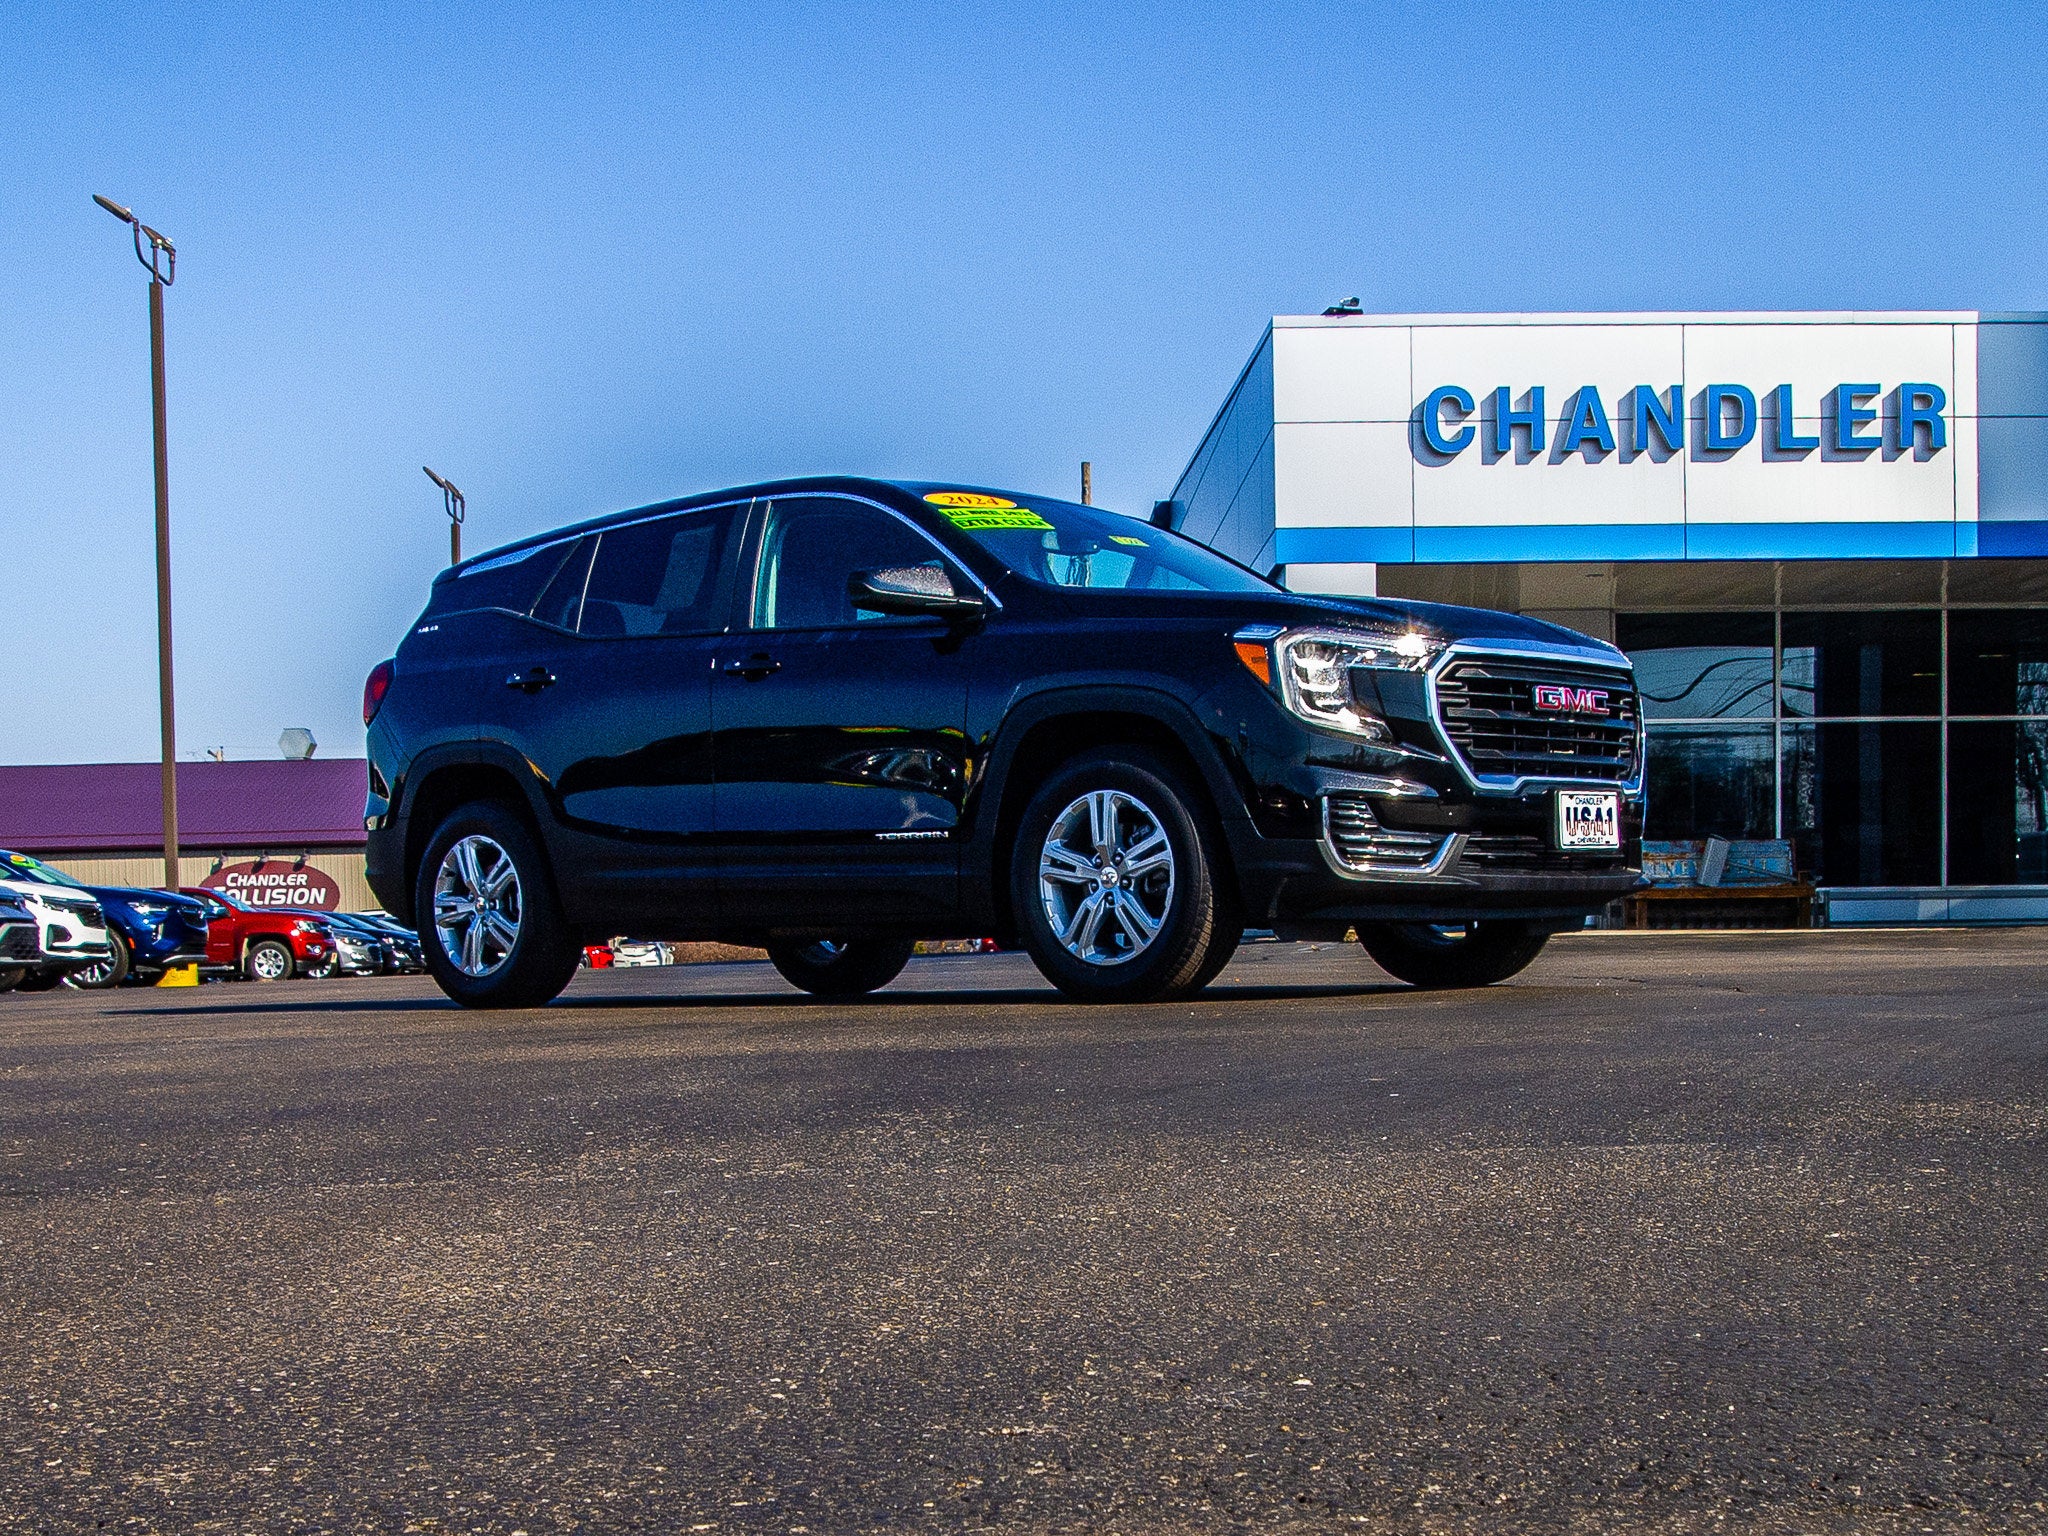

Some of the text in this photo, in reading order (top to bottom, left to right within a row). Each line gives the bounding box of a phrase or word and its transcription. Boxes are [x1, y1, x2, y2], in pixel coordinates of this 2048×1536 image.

[1420, 383, 1948, 455] CHANDLER
[943, 495, 999, 506] 2024
[955, 518, 1003, 528] EXTRA
[1533, 684, 1610, 715] GMC
[1575, 796, 1603, 806] CHANDLER
[875, 831, 949, 840] TERRAIN
[225, 872, 308, 887] CHANDLER
